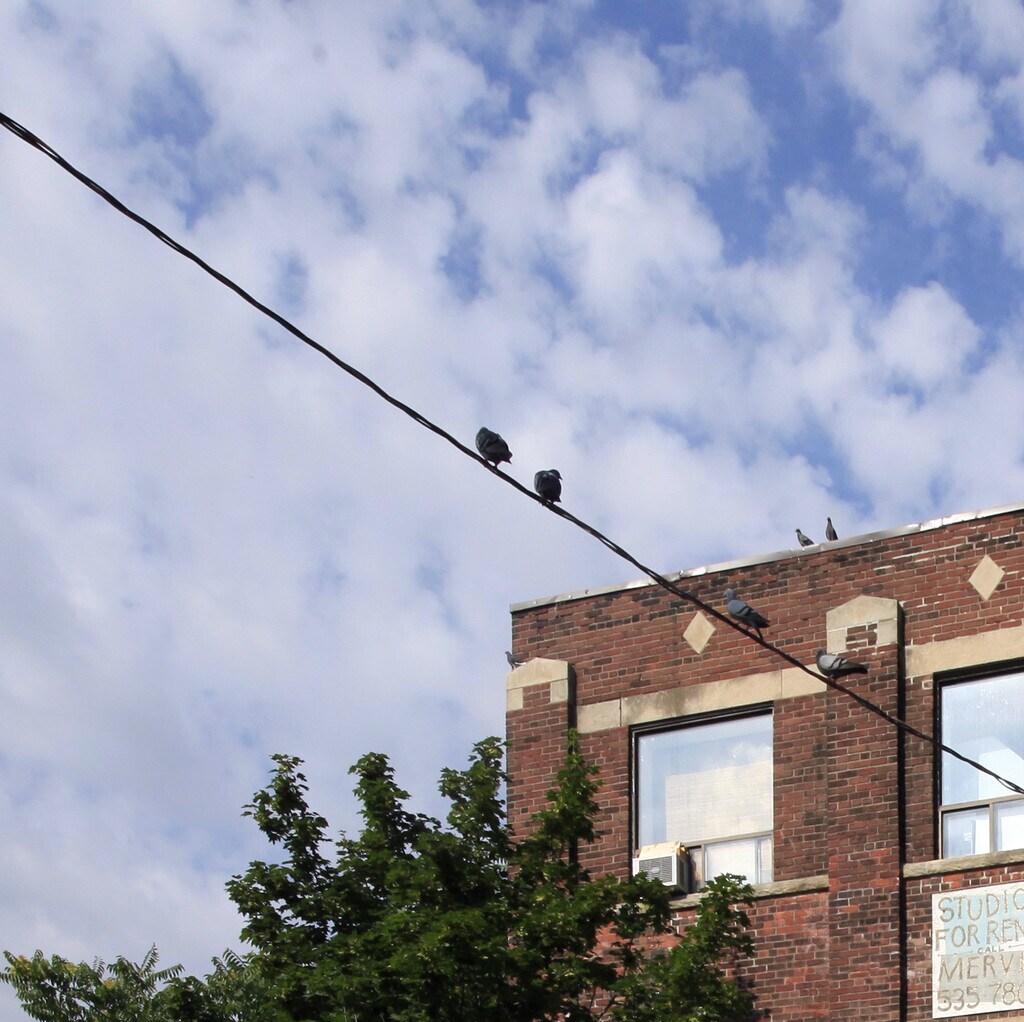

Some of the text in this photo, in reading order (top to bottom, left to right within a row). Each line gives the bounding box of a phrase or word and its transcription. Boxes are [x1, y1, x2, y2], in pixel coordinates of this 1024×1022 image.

[935, 925, 980, 950] FOR
[977, 946, 1004, 955] CALL
[937, 985, 980, 1012] 535
